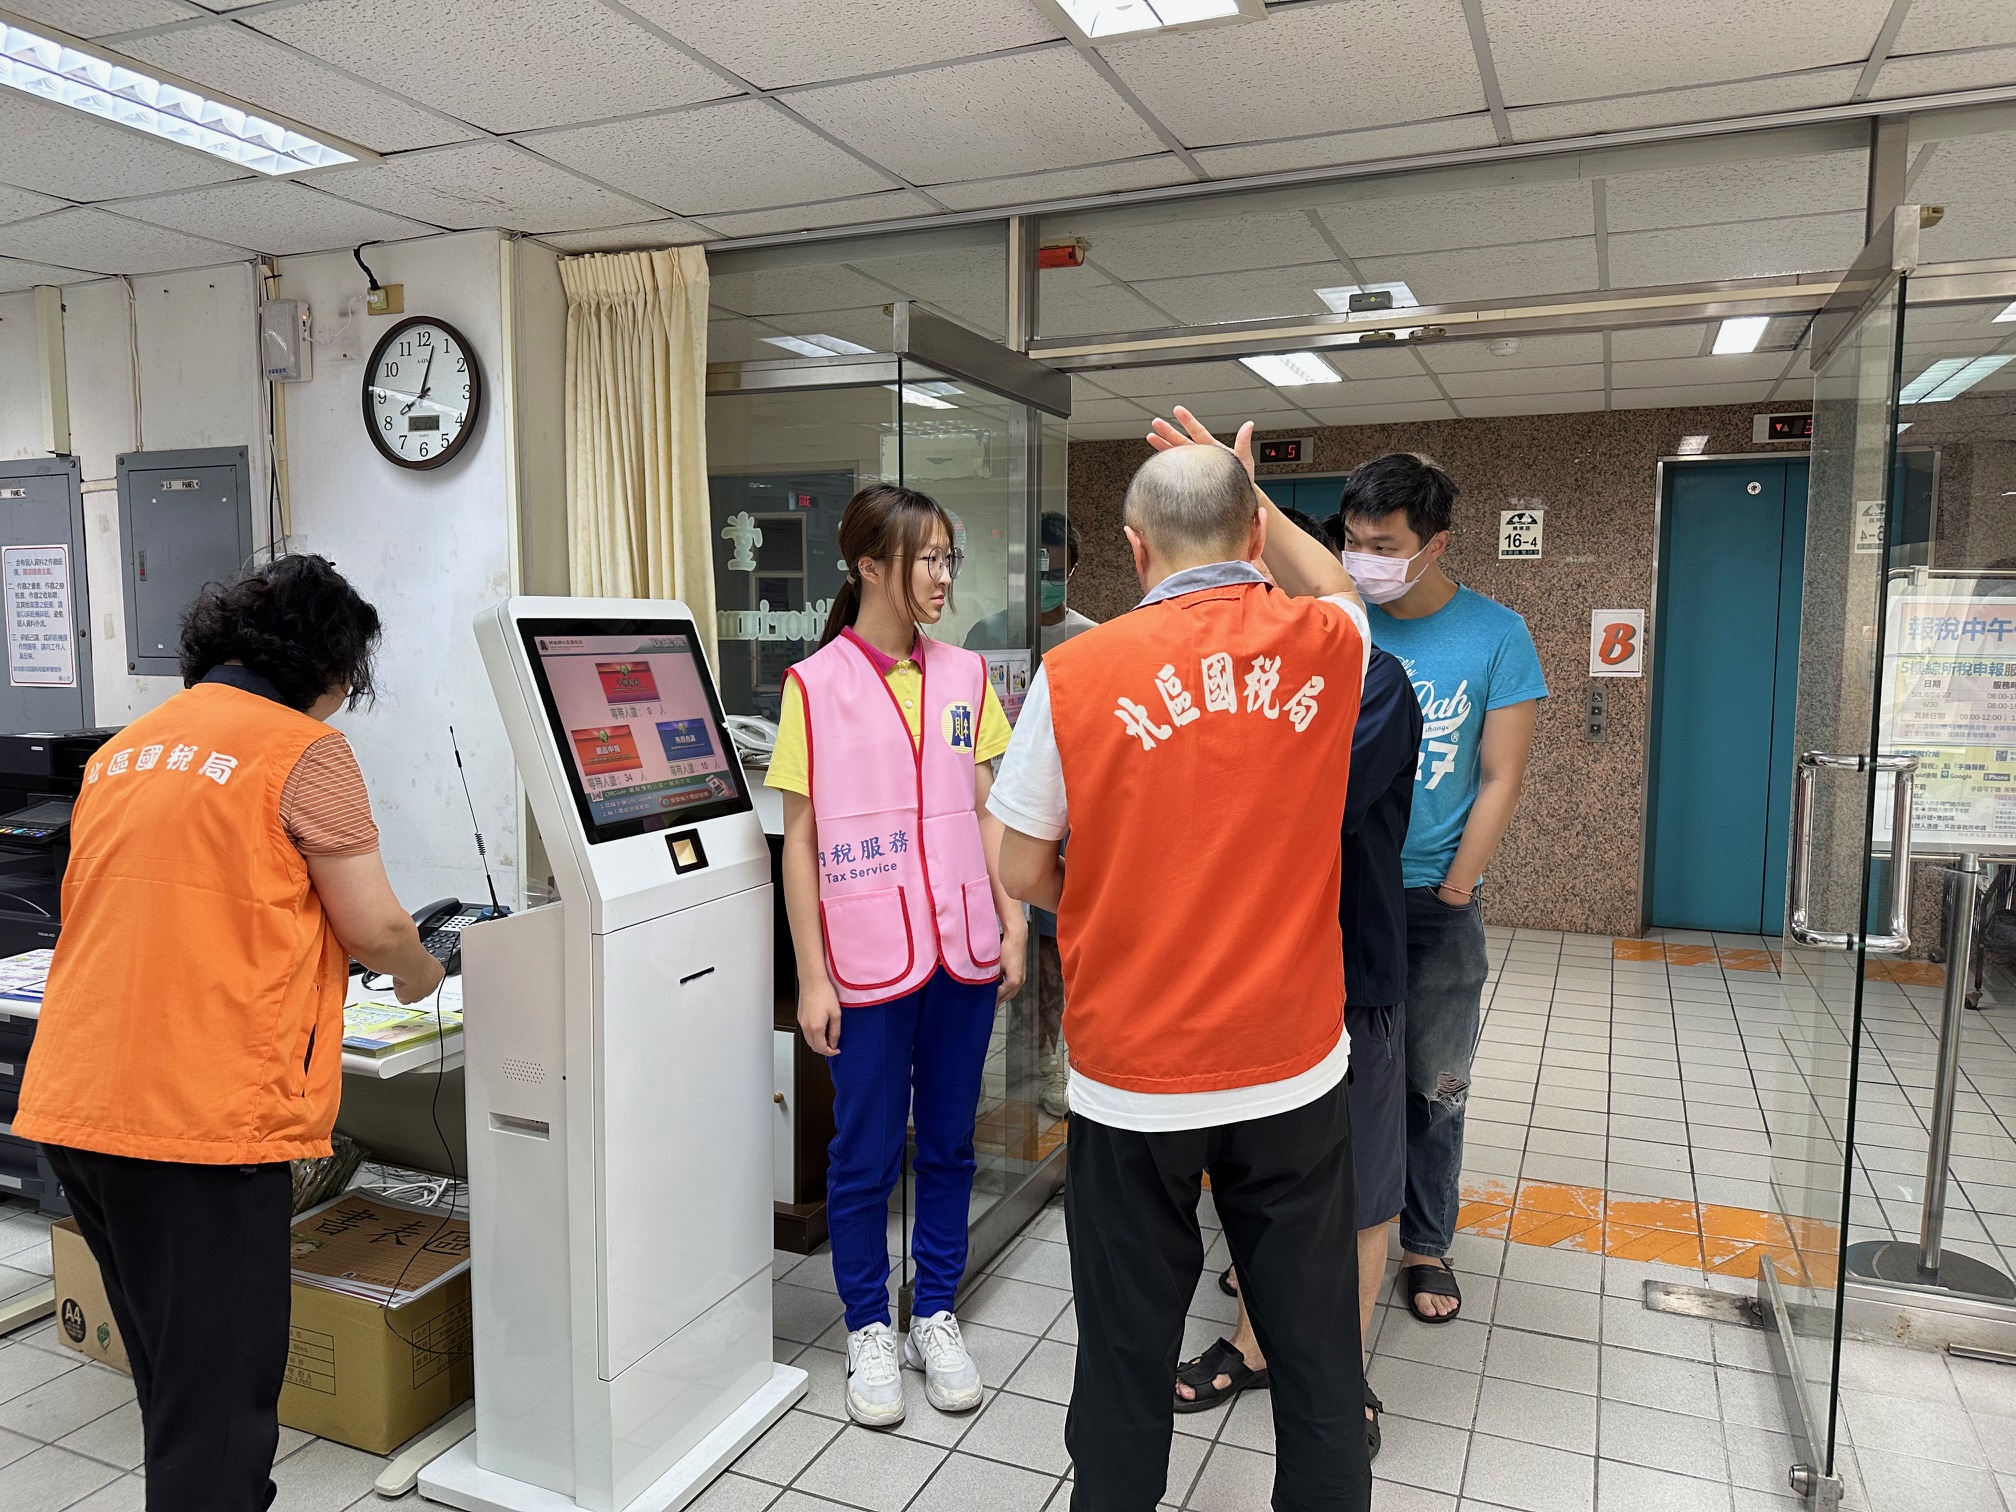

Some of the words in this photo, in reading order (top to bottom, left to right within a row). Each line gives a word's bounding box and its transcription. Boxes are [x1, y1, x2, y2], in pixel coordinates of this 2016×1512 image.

[417, 331, 431, 347] 12
[444, 339, 450, 354] 1
[399, 341, 412, 357] 11
[385, 362, 399, 377] 10
[456, 357, 466, 373] 2
[378, 390, 387, 404] 9
[462, 384, 471, 400] 3
[384, 415, 393, 431] 8
[455, 413, 464, 427] 4
[399, 435, 407, 450] 7
[441, 433, 449, 448] 5
[419, 442, 428, 457] 6
[1288, 444, 1296, 458] 5
[182, 481, 196, 489] PANEL
[1504, 533, 1537, 548] 16-4
[1908, 617, 2016, 641] 報稅中午
[1599, 622, 1637, 666] B
[1924, 680, 1941, 688] 日期
[1114, 652, 1325, 751] 北區國稅局
[624, 773, 633, 783] 34
[825, 873, 847, 884] Tax
[850, 862, 898, 879] Service
[65, 1302, 81, 1325] A4
